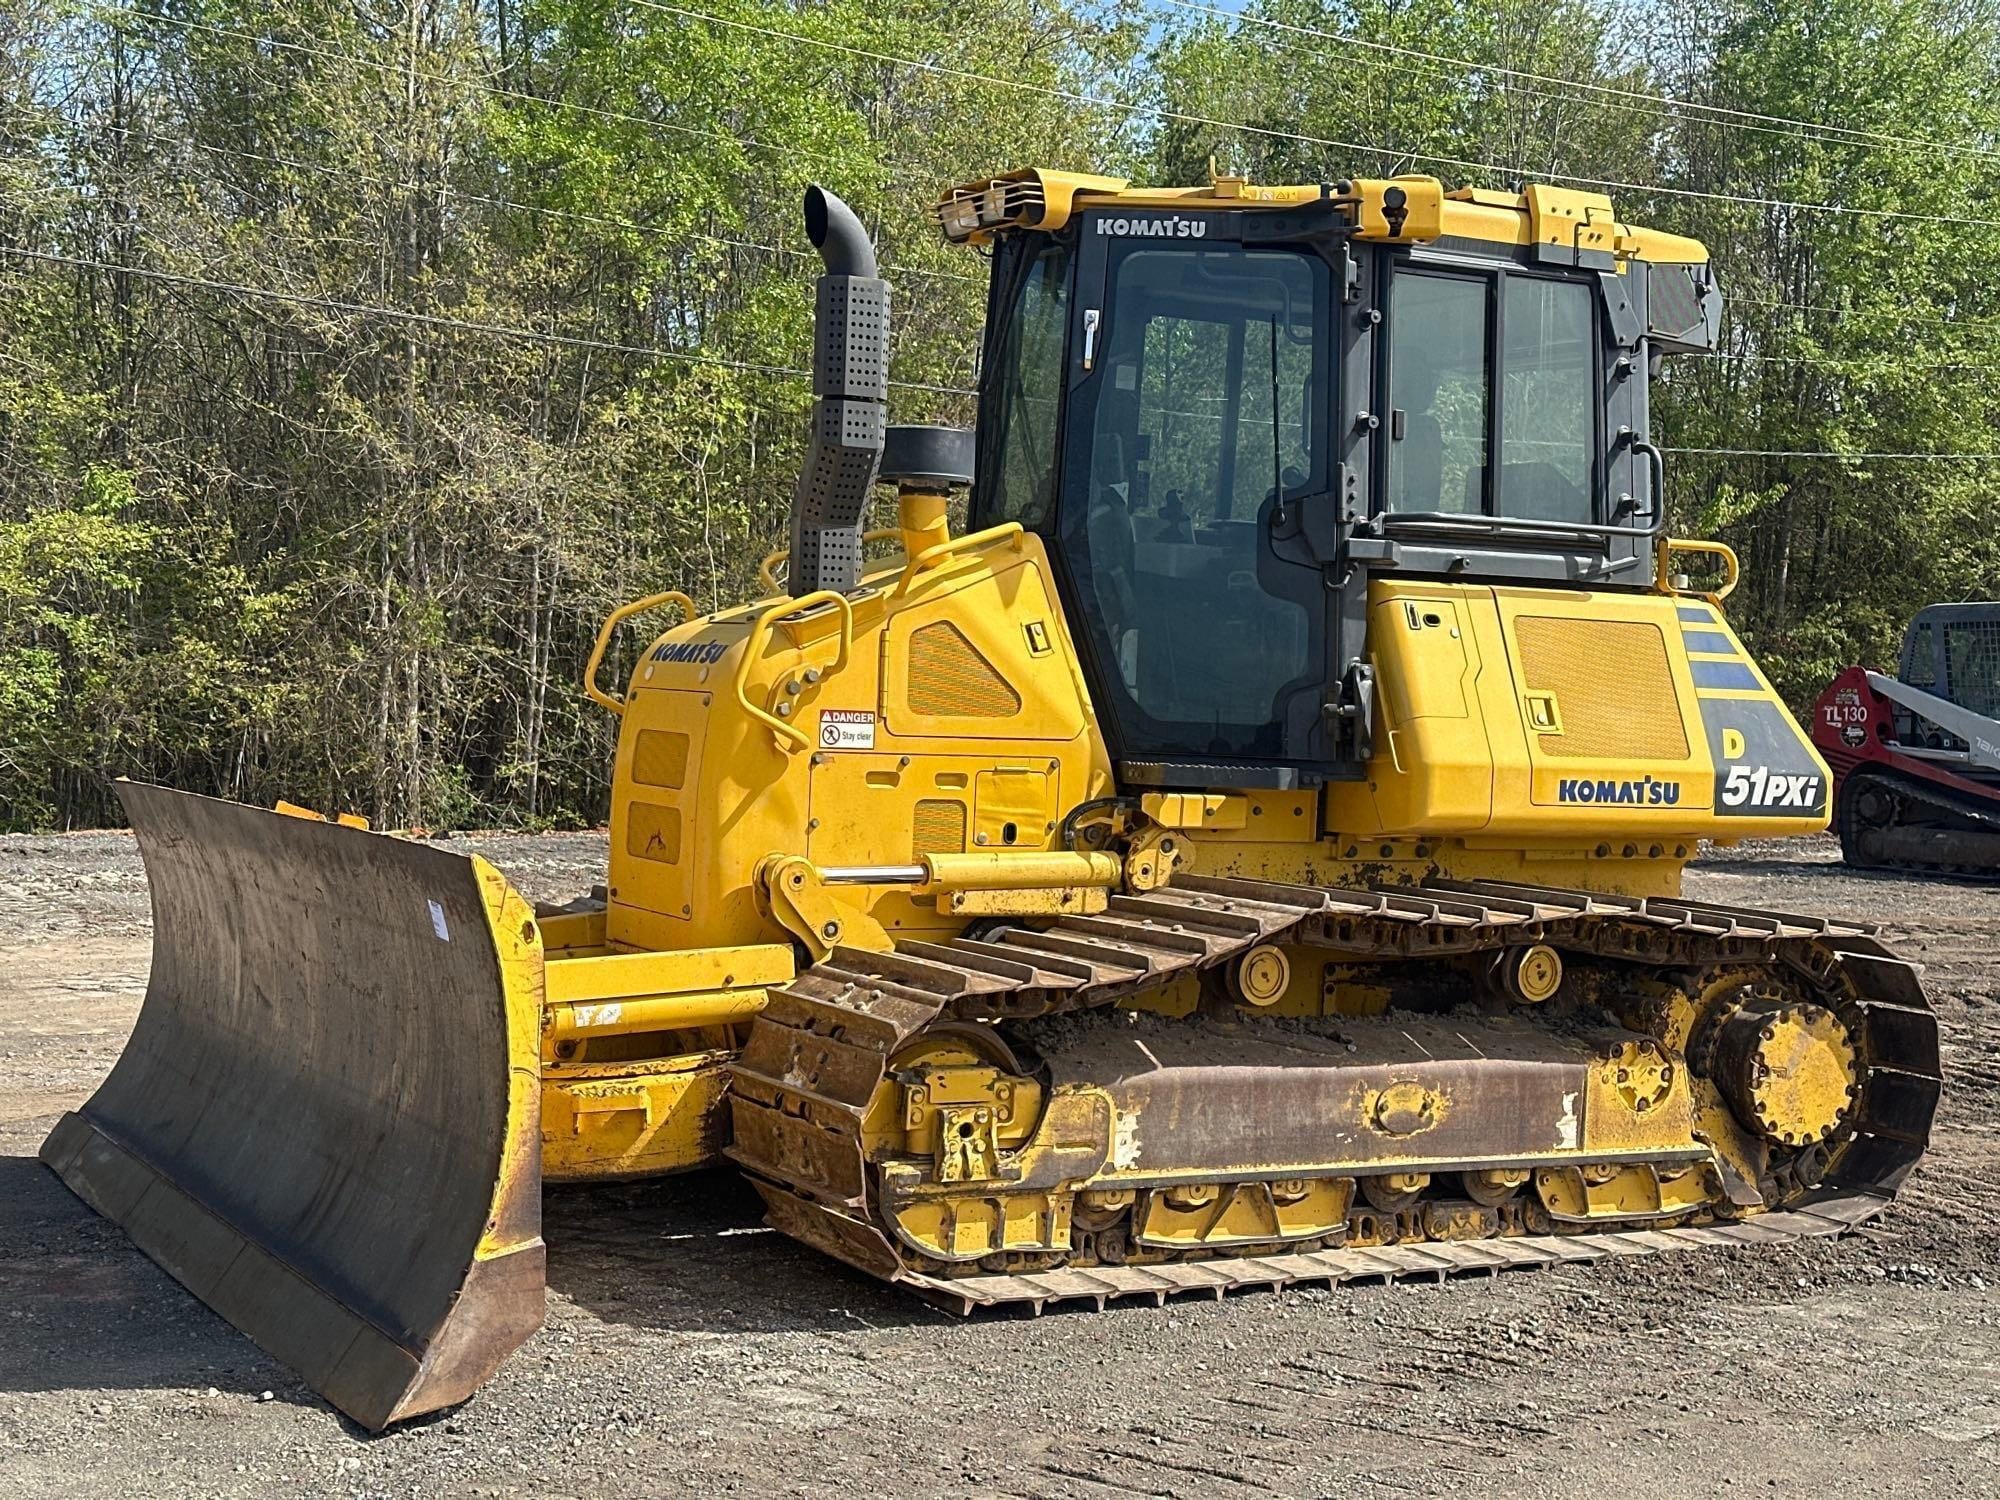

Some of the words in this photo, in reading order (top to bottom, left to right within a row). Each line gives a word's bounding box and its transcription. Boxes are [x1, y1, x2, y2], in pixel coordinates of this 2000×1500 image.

[1097, 216, 1206, 237] KOMATSU
[650, 640, 729, 664] KOMATSU
[832, 711, 874, 723] DANGER
[842, 731, 855, 742] Stay
[857, 732, 872, 740] clear
[1722, 728, 1746, 759] D
[1559, 775, 1680, 804] KOMATSU
[1722, 765, 1819, 807] 51PXi
